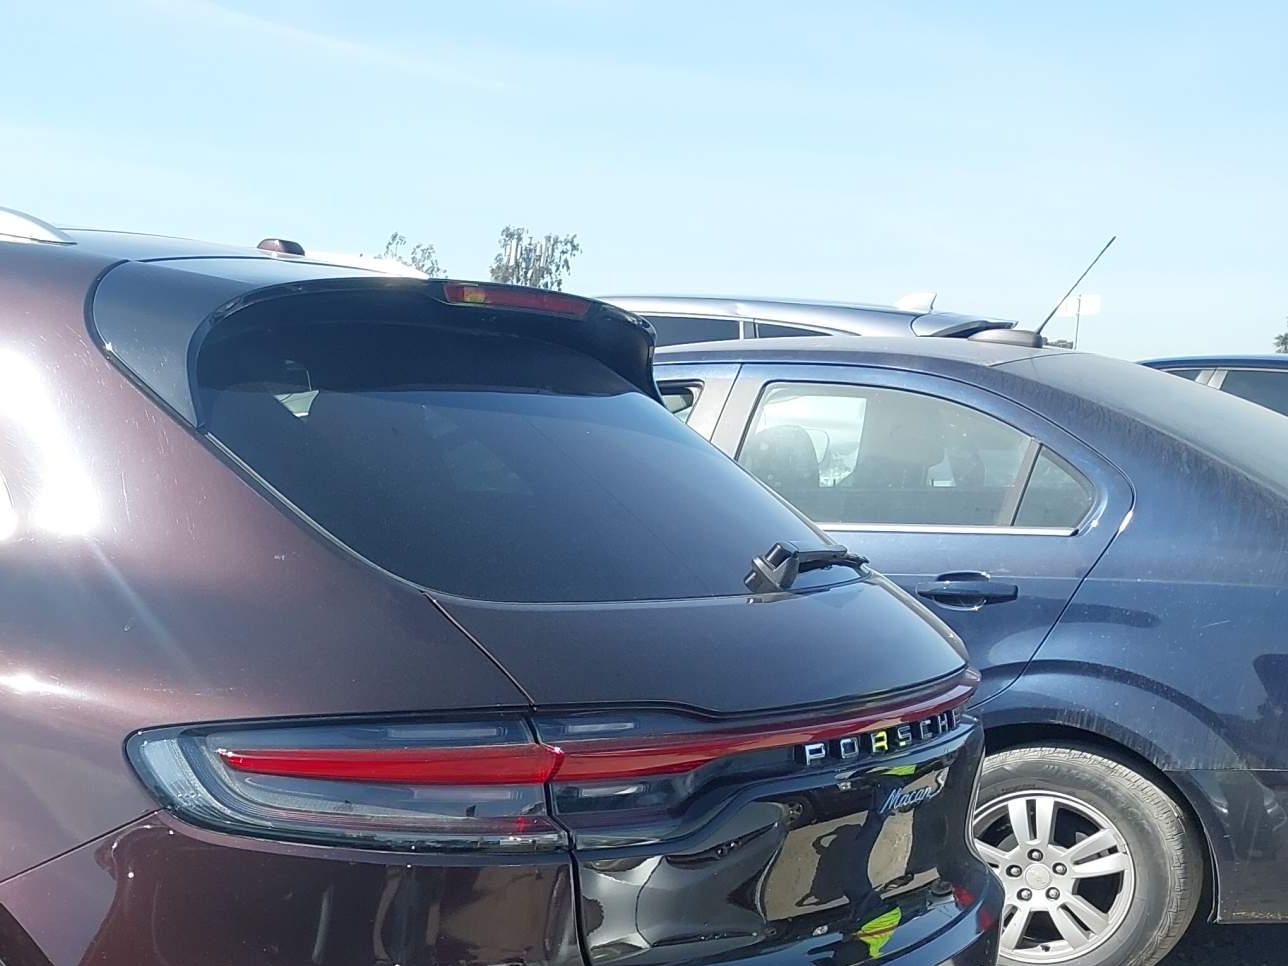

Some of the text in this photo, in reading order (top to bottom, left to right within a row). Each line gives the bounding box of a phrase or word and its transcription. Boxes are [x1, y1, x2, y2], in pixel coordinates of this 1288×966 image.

[805, 711, 964, 766] PORSCHE
[879, 766, 950, 814] Macan S
